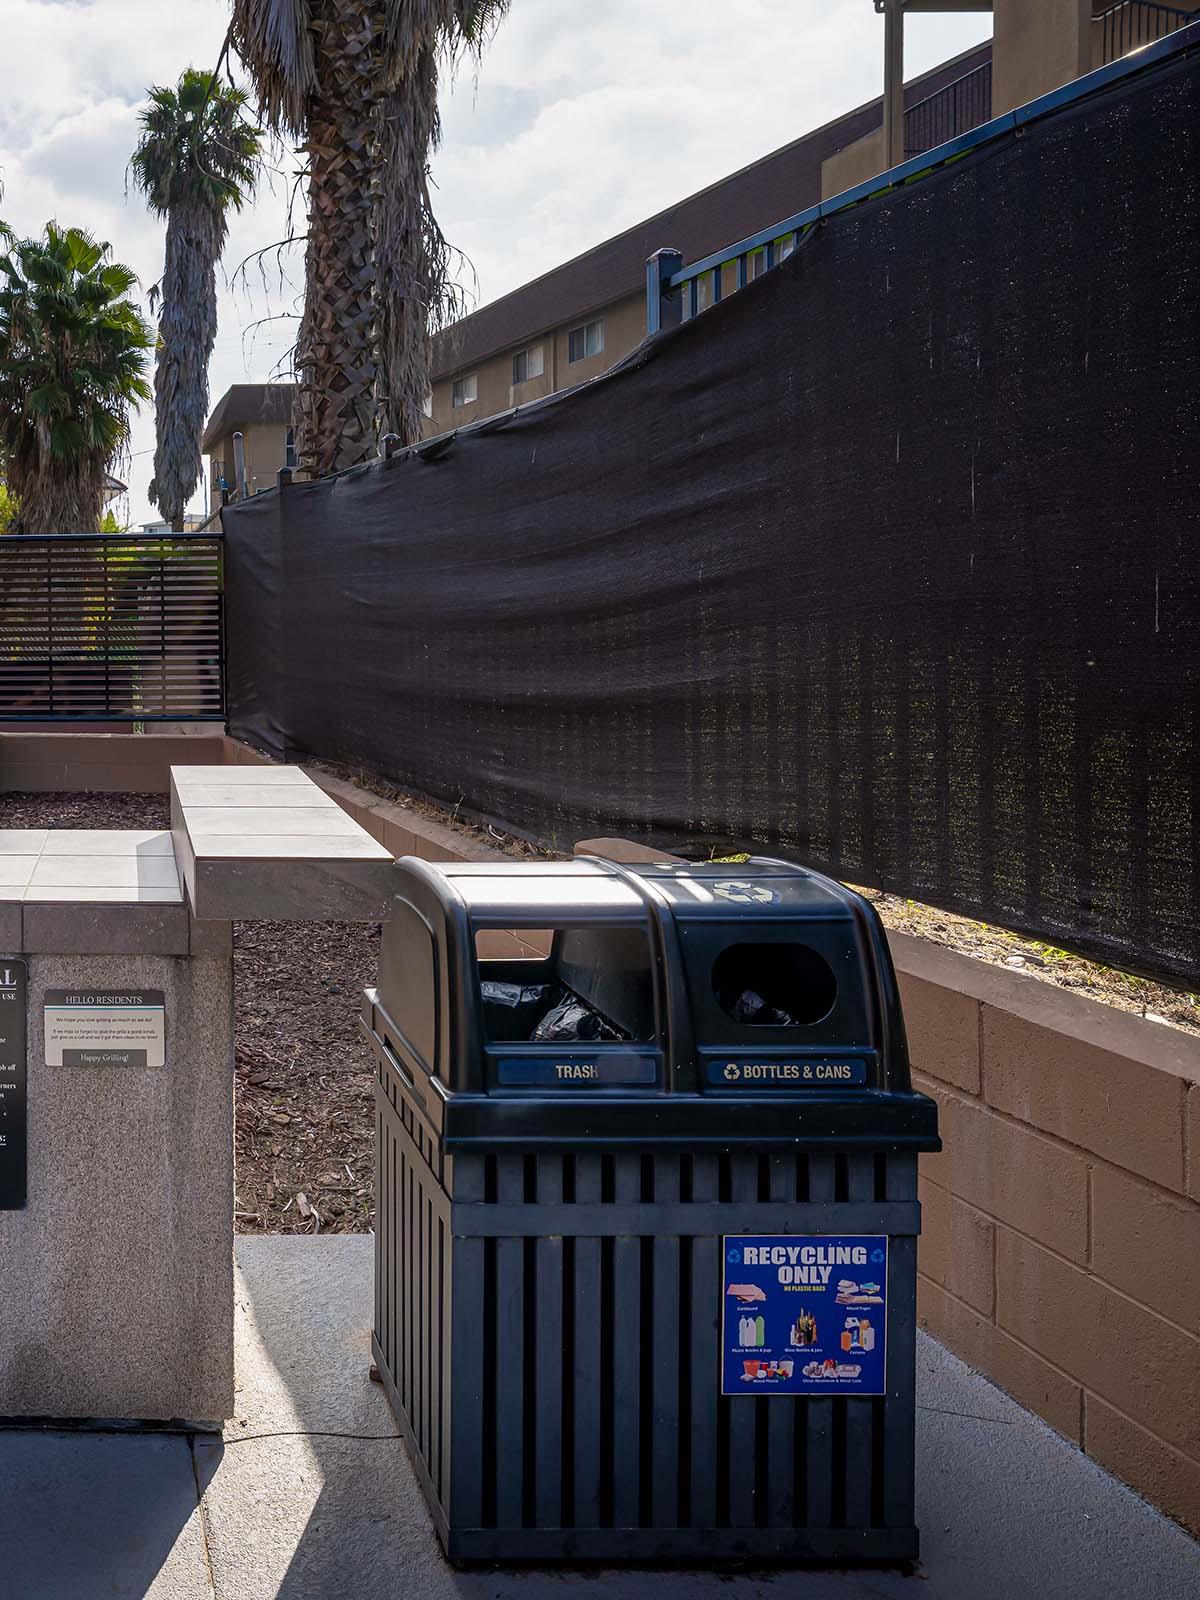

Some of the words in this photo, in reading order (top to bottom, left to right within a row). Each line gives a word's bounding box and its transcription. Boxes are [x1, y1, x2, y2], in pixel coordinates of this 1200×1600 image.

[65, 996, 95, 1004] HELLO
[96, 996, 143, 1004] RESIDENTS
[555, 1064, 599, 1078] TRASH
[743, 1065, 800, 1079] BOTTLES
[803, 1065, 813, 1079] &
[816, 1065, 852, 1079] CANS
[743, 1246, 868, 1265] RECYCLING
[777, 1265, 833, 1285] ONLY
